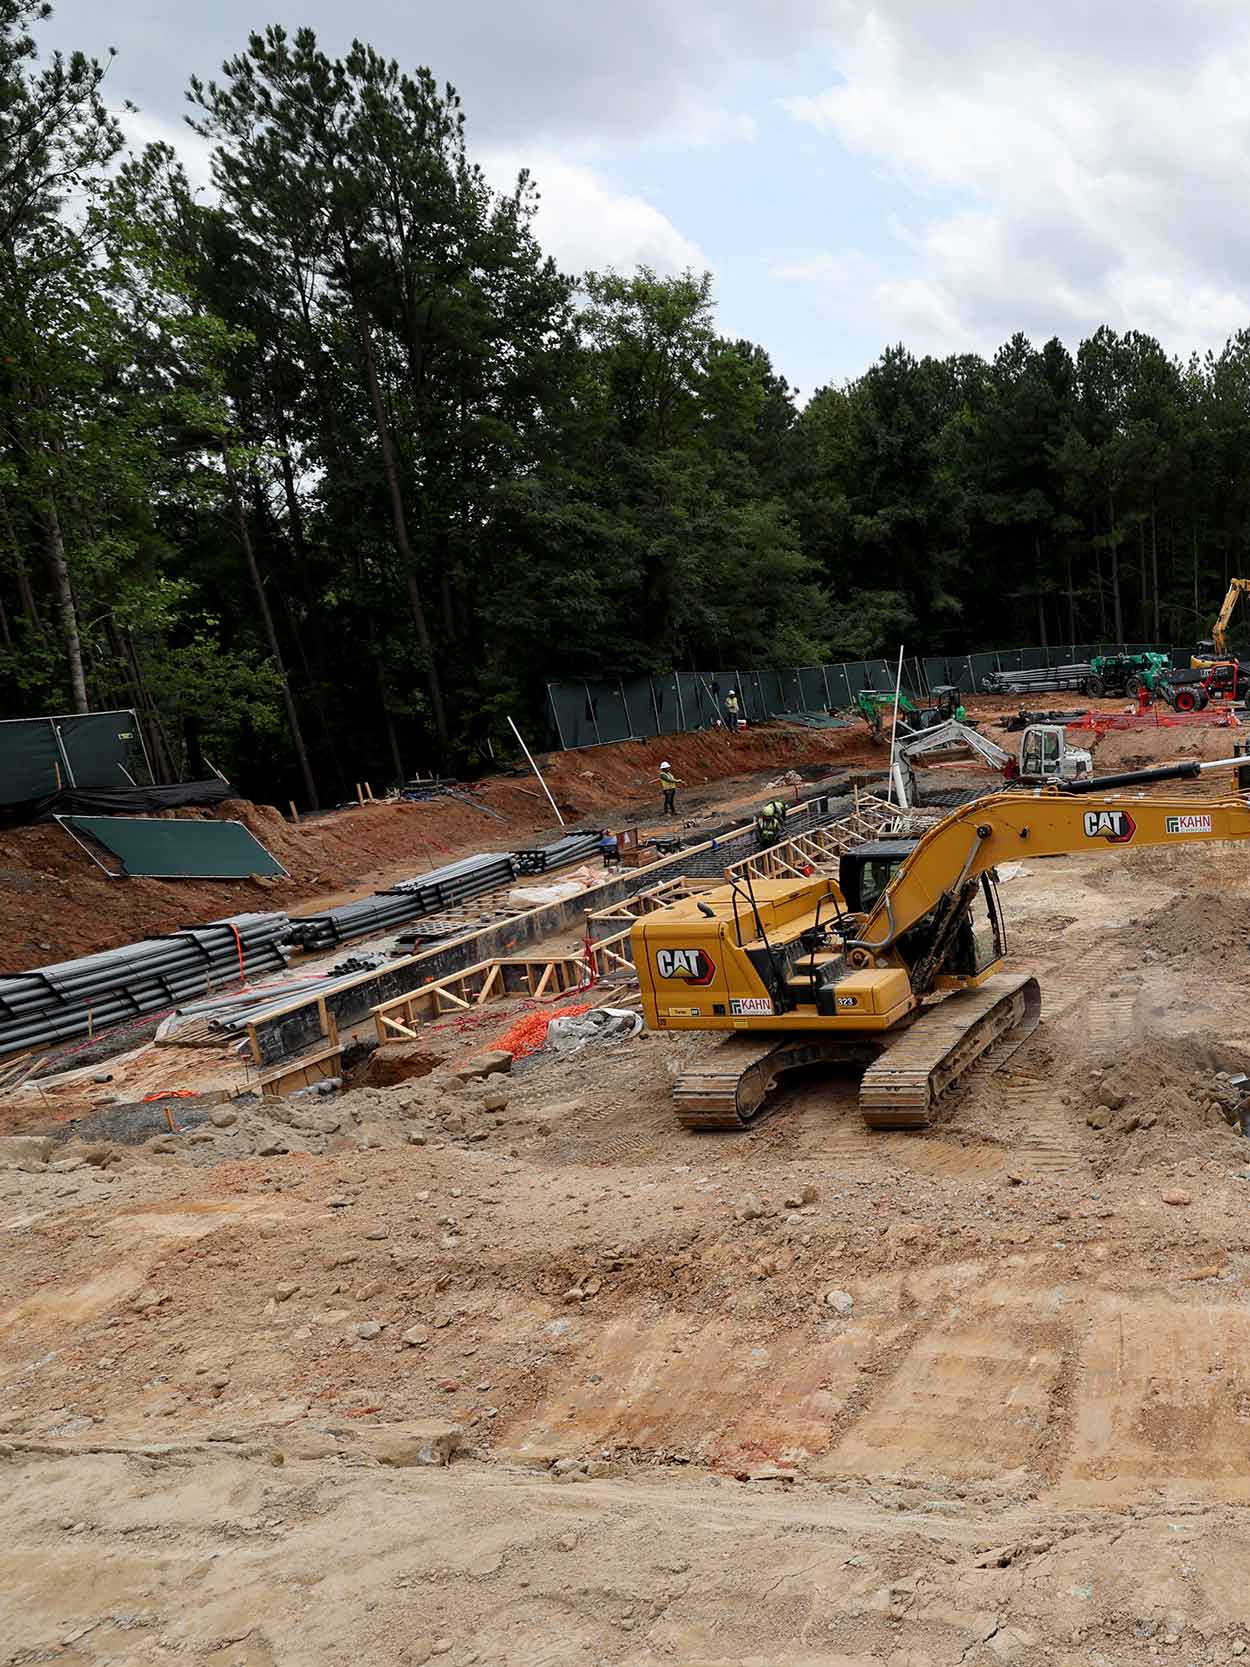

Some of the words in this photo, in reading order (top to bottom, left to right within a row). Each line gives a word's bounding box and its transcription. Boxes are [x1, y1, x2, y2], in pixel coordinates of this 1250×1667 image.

[1084, 811, 1122, 836] CAT
[1180, 816, 1211, 828] KAHN
[656, 950, 699, 978] CAT
[741, 1000, 771, 1010] KAHN
